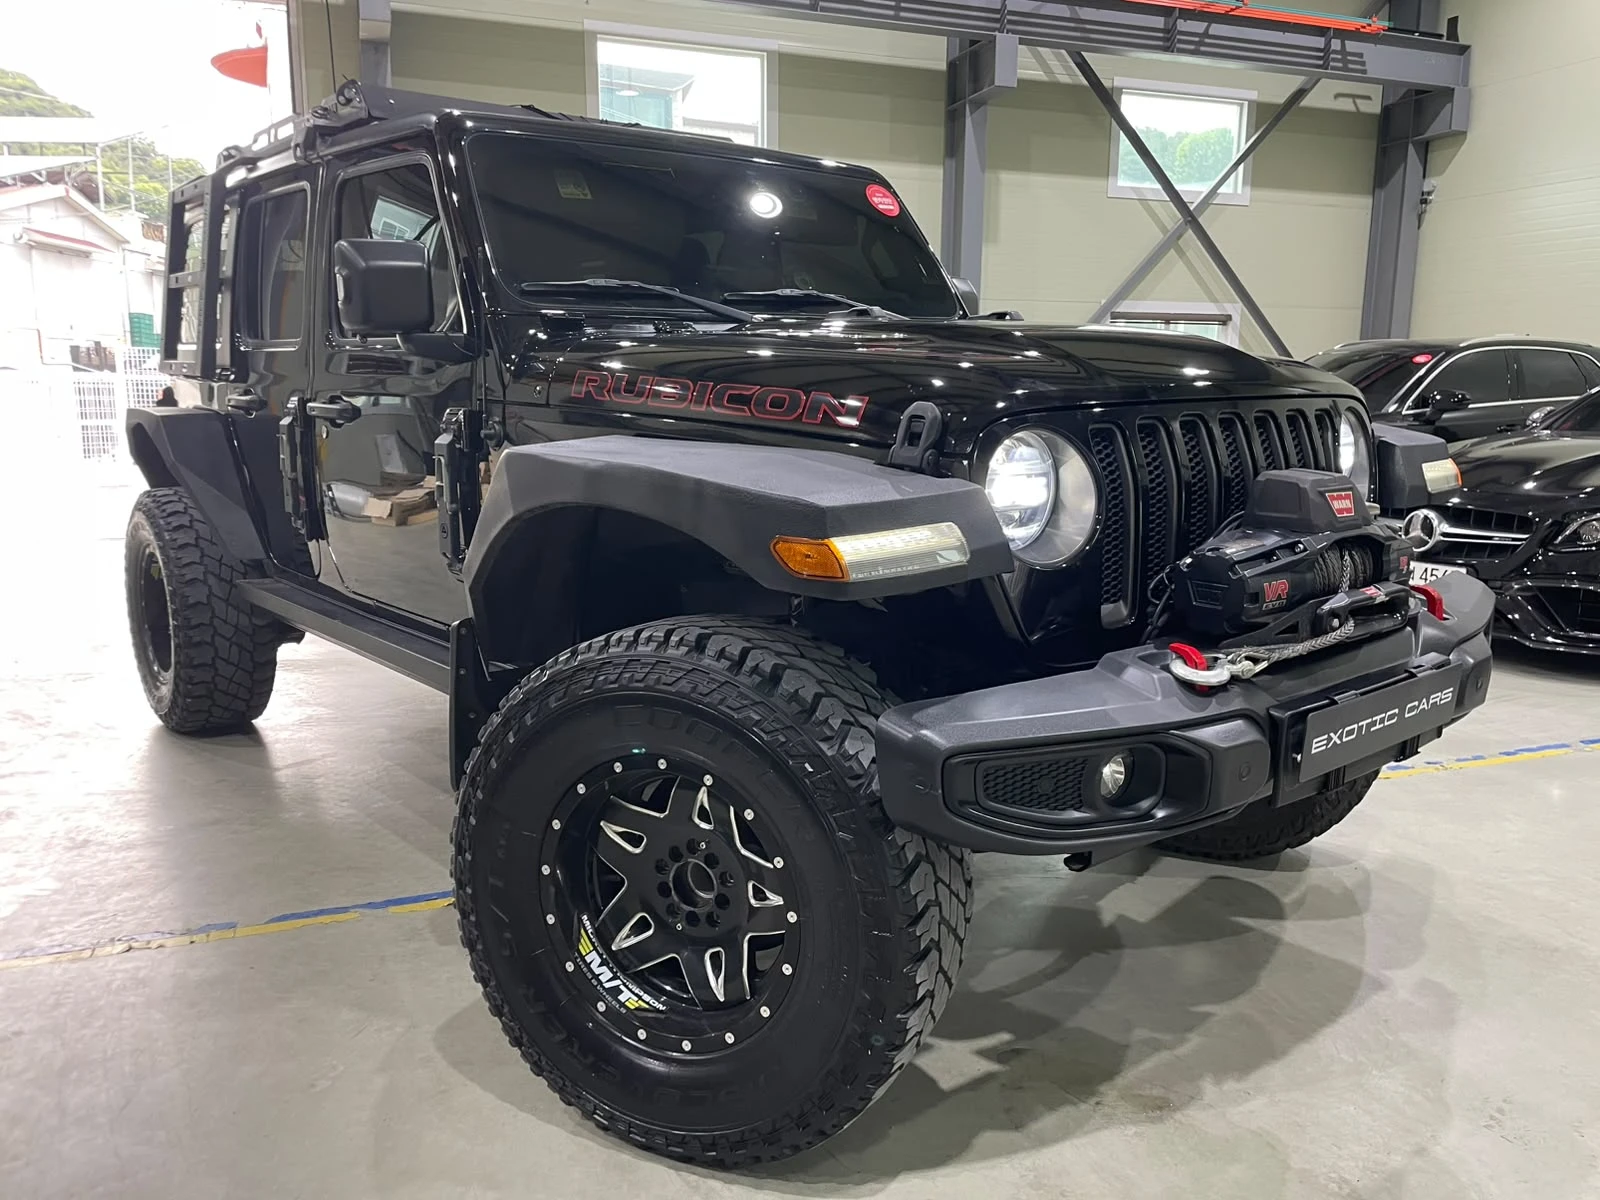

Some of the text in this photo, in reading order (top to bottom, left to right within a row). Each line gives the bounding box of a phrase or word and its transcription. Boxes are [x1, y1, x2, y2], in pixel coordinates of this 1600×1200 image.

[571, 369, 870, 429] RUBICON
[1263, 579, 1289, 602] VR
[1310, 686, 1454, 756] EXOTIC CARS
[584, 949, 640, 1003] M/T
[596, 983, 628, 1015] WHEELS
